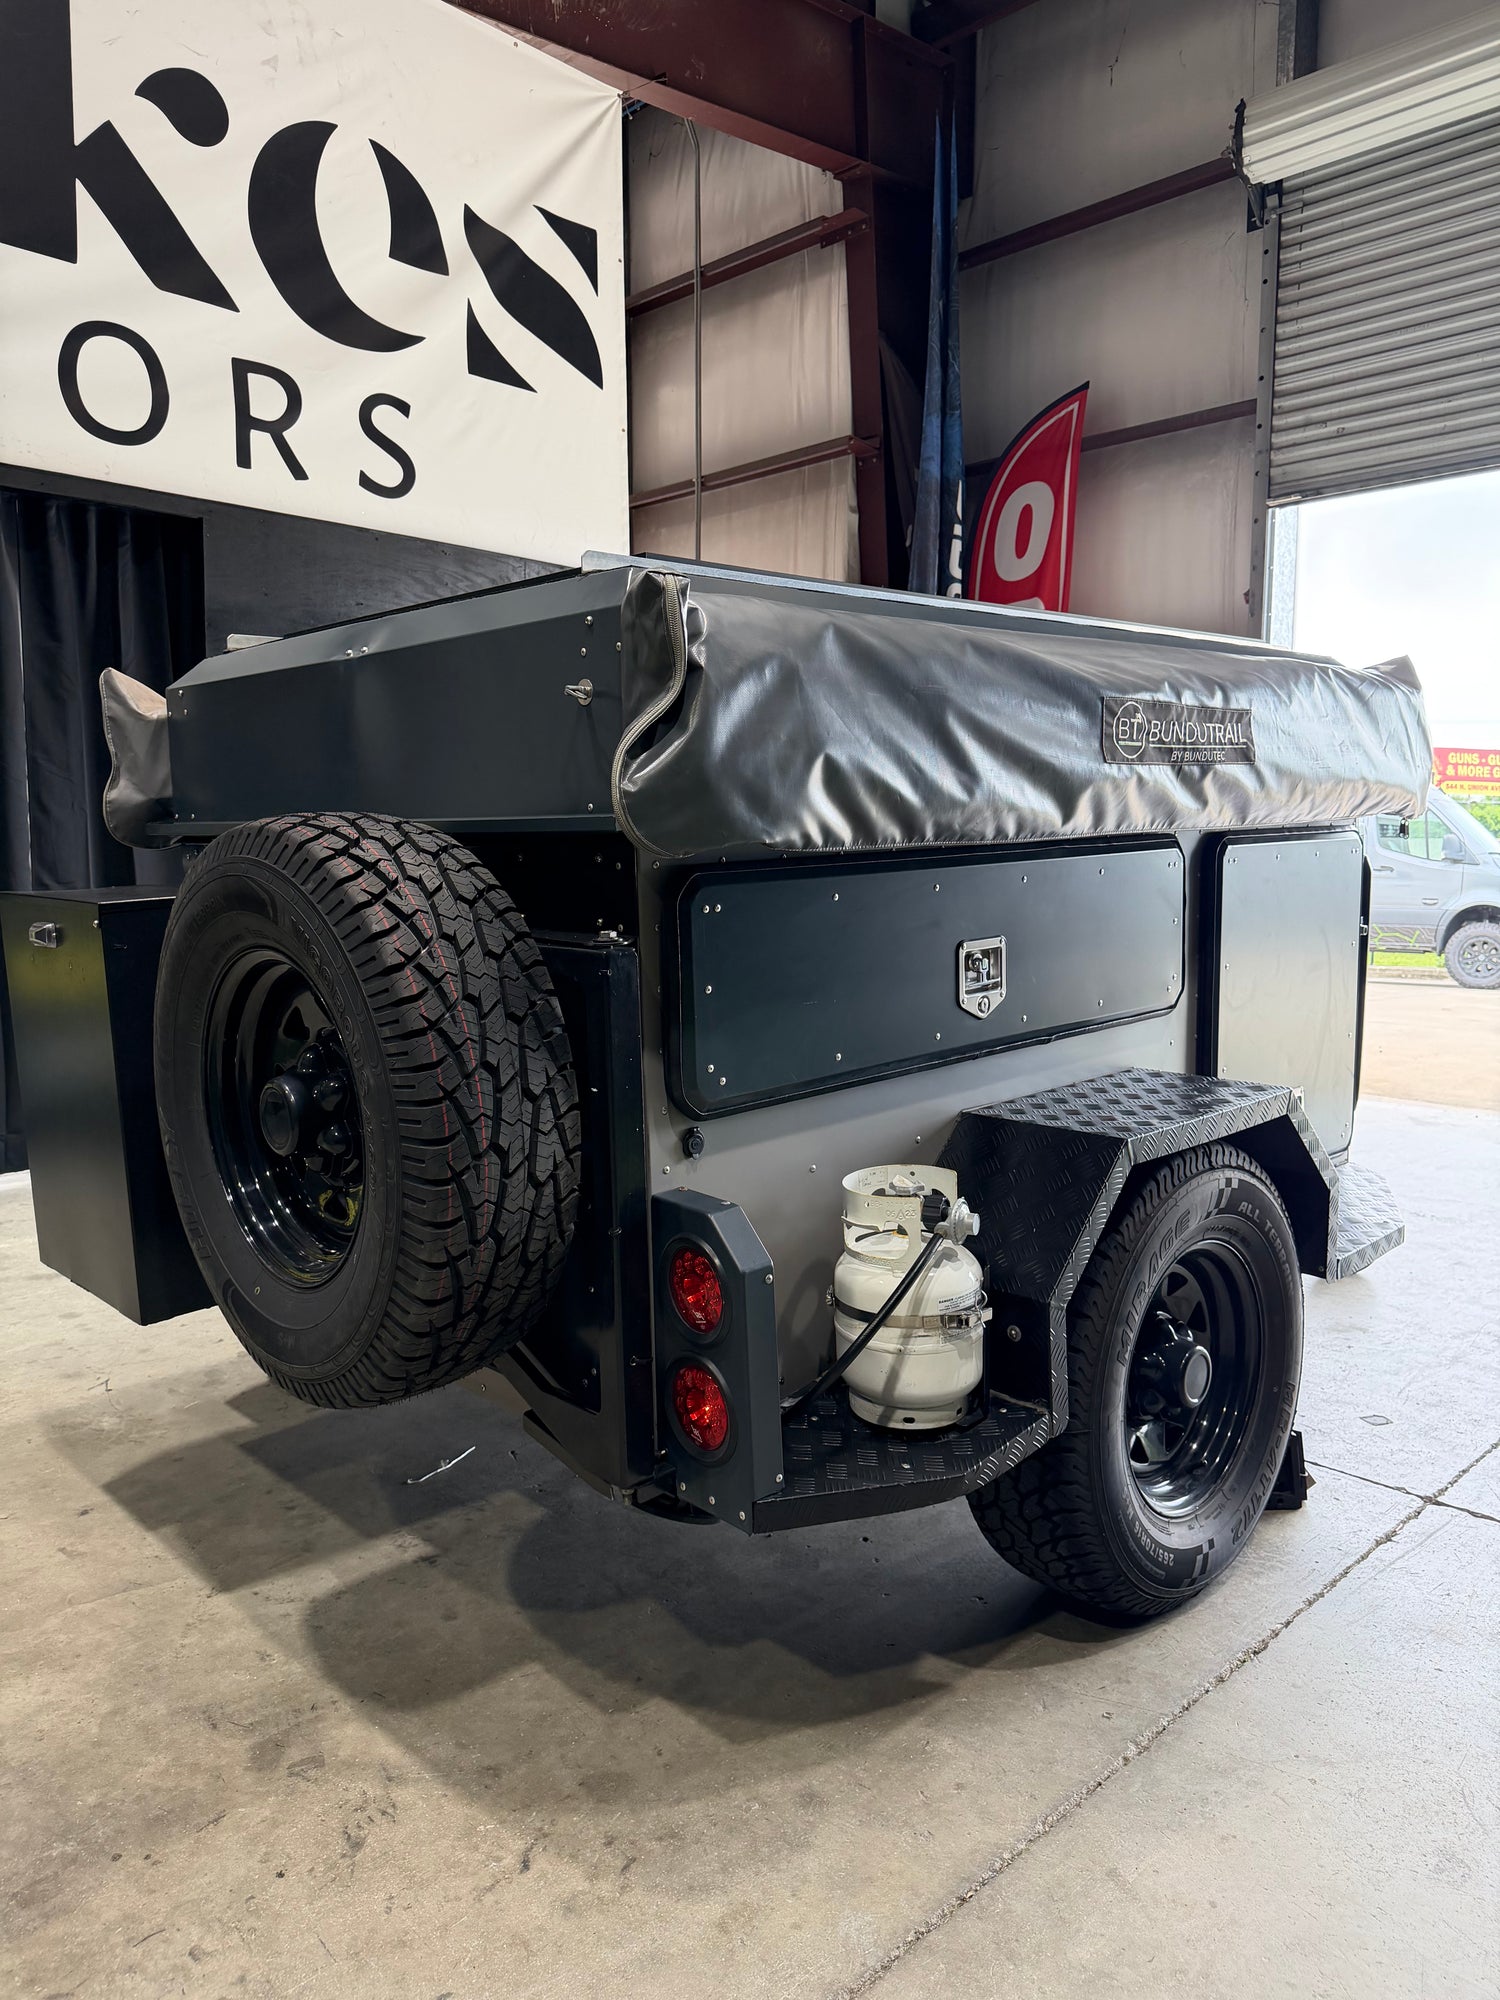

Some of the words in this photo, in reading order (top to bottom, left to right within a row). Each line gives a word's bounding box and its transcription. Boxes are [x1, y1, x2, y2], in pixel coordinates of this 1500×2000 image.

[58, 320, 417, 499] ORS
[1149, 720, 1247, 744] BUNDUTRAIL
[1171, 751, 1183, 762] BY
[1184, 751, 1226, 762] BUNDUTEC
[1448, 751, 1480, 765] GUNS
[1446, 765, 1456, 776] &
[1457, 764, 1491, 778] MORE
[1237, 1200, 1261, 1223] ALL
[1263, 1218, 1296, 1296] TERRAIN
[1116, 1207, 1192, 1368] MIRAGE
